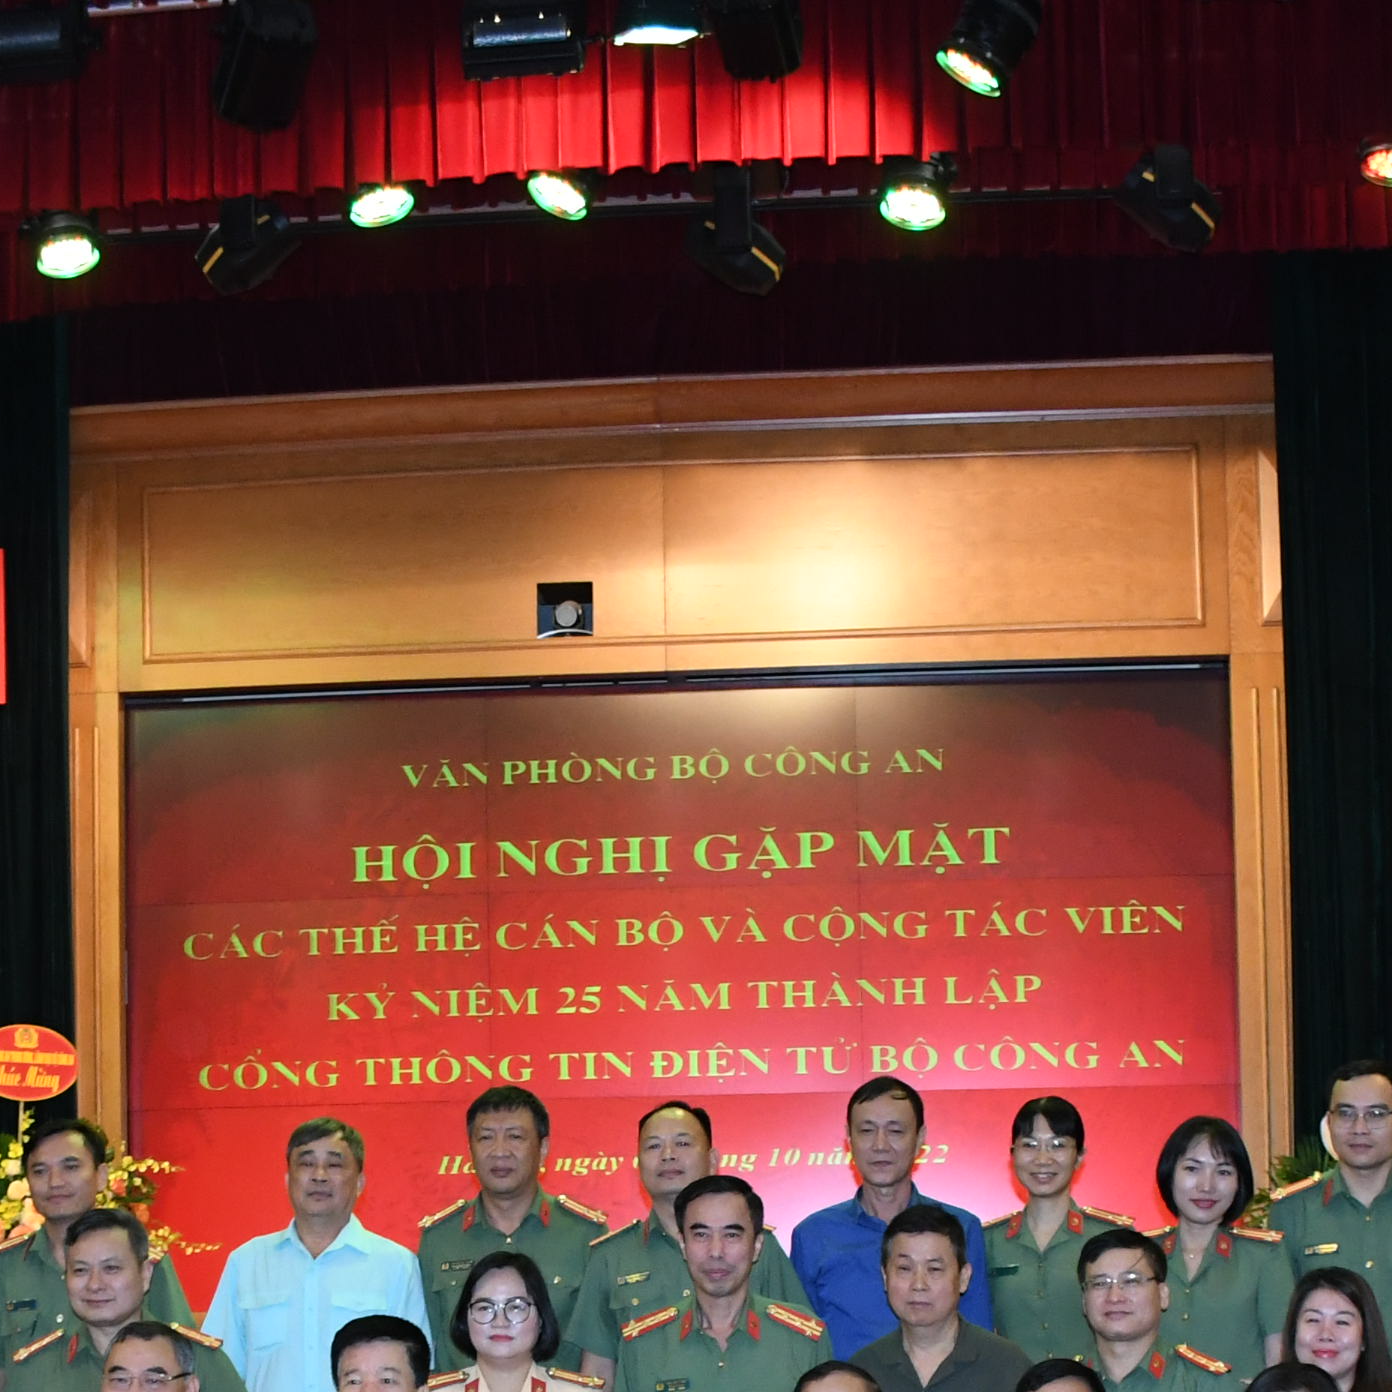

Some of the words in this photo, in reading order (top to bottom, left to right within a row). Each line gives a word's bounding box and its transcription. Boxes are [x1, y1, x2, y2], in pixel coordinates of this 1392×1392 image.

[402, 757, 489, 787] VĂN
[502, 752, 657, 785] PHÒNG
[671, 748, 730, 783] BỘ
[744, 746, 869, 777] CÔNG
[885, 748, 944, 774] AN
[352, 834, 476, 890] HỘI
[496, 836, 673, 882] NGHỊ
[693, 827, 835, 879] GẶP
[856, 823, 1011, 875] MẶT
[183, 924, 284, 961] CÁC
[299, 914, 399, 956] THẾ
[415, 916, 482, 958] HỆ
[495, 914, 599, 950] CÁN
[616, 911, 684, 952] BỘ
[699, 908, 768, 944] VÀ
[783, 906, 929, 947] CỘNG
[945, 901, 1049, 938] TÁC
[1065, 899, 1186, 936] VIÊN
[327, 983, 396, 1021] KỶ
[411, 982, 540, 1023] NIỆM
[556, 985, 603, 1015] 25
[617, 979, 732, 1012] NĂM
[747, 972, 927, 1010] THÀNH
[944, 969, 1043, 1010] LẬP
[198, 1049, 340, 1091] CỔNG
[355, 1049, 535, 1086] THÔNG
[549, 1051, 634, 1081] TIN
[650, 1043, 771, 1083] ĐIỆN
[786, 1037, 859, 1075] TỬ
[870, 1037, 939, 1079] BỘ
[953, 1035, 1101, 1071] CÔNG
[1119, 1039, 1186, 1069] AN
[554, 1151, 624, 1176] ngày
[768, 1148, 802, 1168] 10
